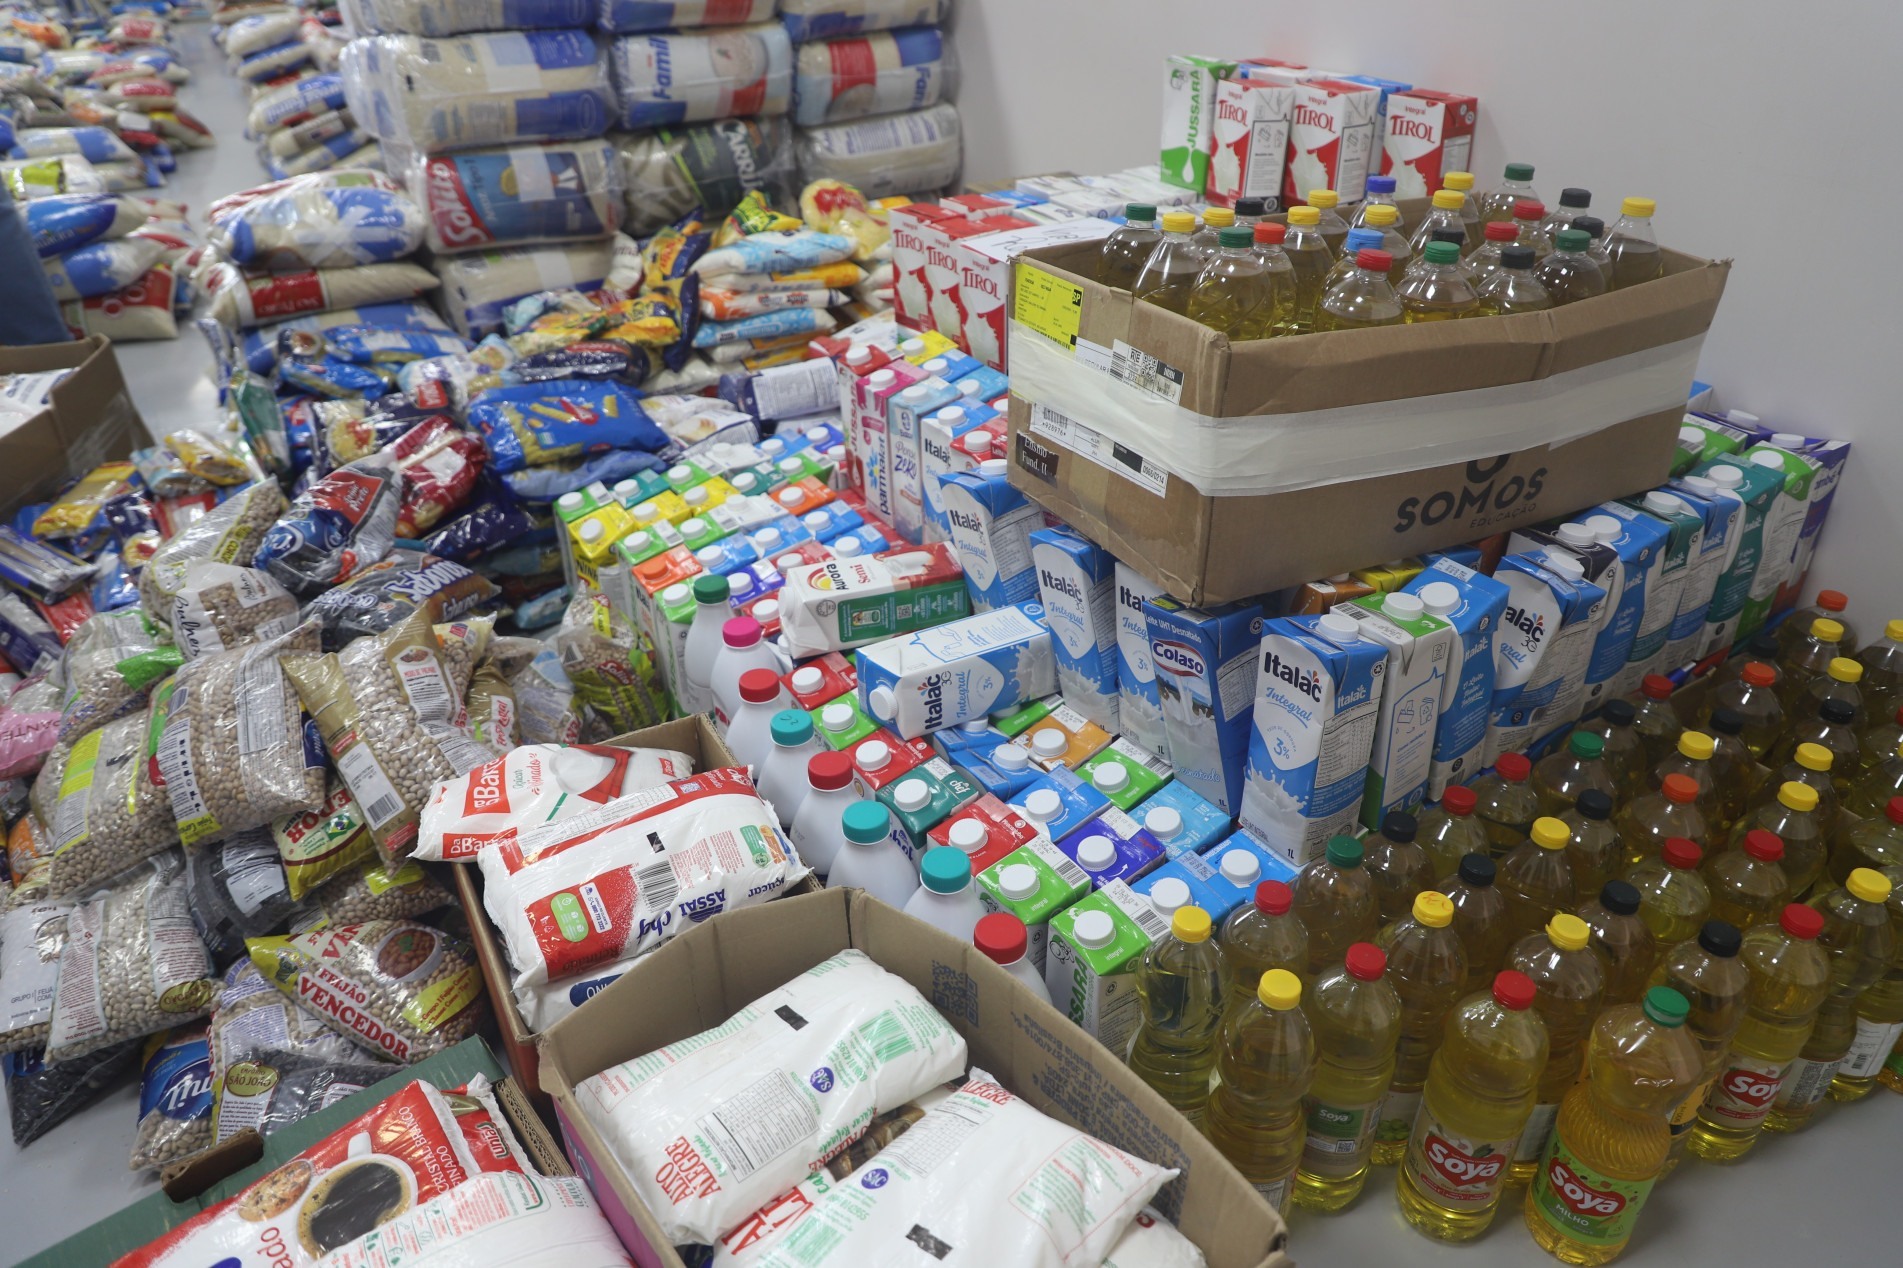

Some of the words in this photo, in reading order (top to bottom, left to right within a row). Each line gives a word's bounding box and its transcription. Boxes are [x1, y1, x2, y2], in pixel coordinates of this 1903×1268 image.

[1188, 69, 1200, 149] JUSSARA
[1218, 99, 1249, 126] TIROL
[1294, 104, 1336, 134] TIROL
[1389, 115, 1436, 144] TIROL
[961, 267, 1000, 300] TIROL
[1393, 468, 1548, 533] SOMOS
[1469, 503, 1537, 529] EDUCAÇÃO
[950, 509, 983, 536] Italac
[958, 539, 988, 563] Integral
[826, 563, 850, 591] Aurora
[850, 564, 870, 584] Semi
[1041, 569, 1082, 603] Italac
[1050, 601, 1084, 626] Integral
[1153, 642, 1204, 674] Colaso
[1264, 652, 1322, 703] Italac
[924, 673, 943, 730] Italac
[956, 671, 967, 719] Integral
[1266, 686, 1313, 722] Integral
[1337, 685, 1366, 709] Italac
[1273, 737, 1290, 760] 3%
[949, 780, 970, 794] chef
[678, 888, 726, 918] ASSAI
[318, 968, 366, 1005] FEIJÃO
[300, 976, 411, 1060] VENCEDOR
[229, 1074, 245, 1085] SÃO
[246, 1077, 271, 1086] JOÃO
[811, 1068, 832, 1092] SAC
[399, 1106, 427, 1148] BRANCO
[420, 1146, 449, 1194] CRISTAL
[664, 1135, 722, 1199] ALEGRE
[862, 1169, 888, 1188] SAC
[1428, 1143, 1500, 1187] Soya
[655, 1161, 694, 1206] ALTO
[1550, 1165, 1620, 1214] Soya
[1555, 1204, 1589, 1227] MILHO
